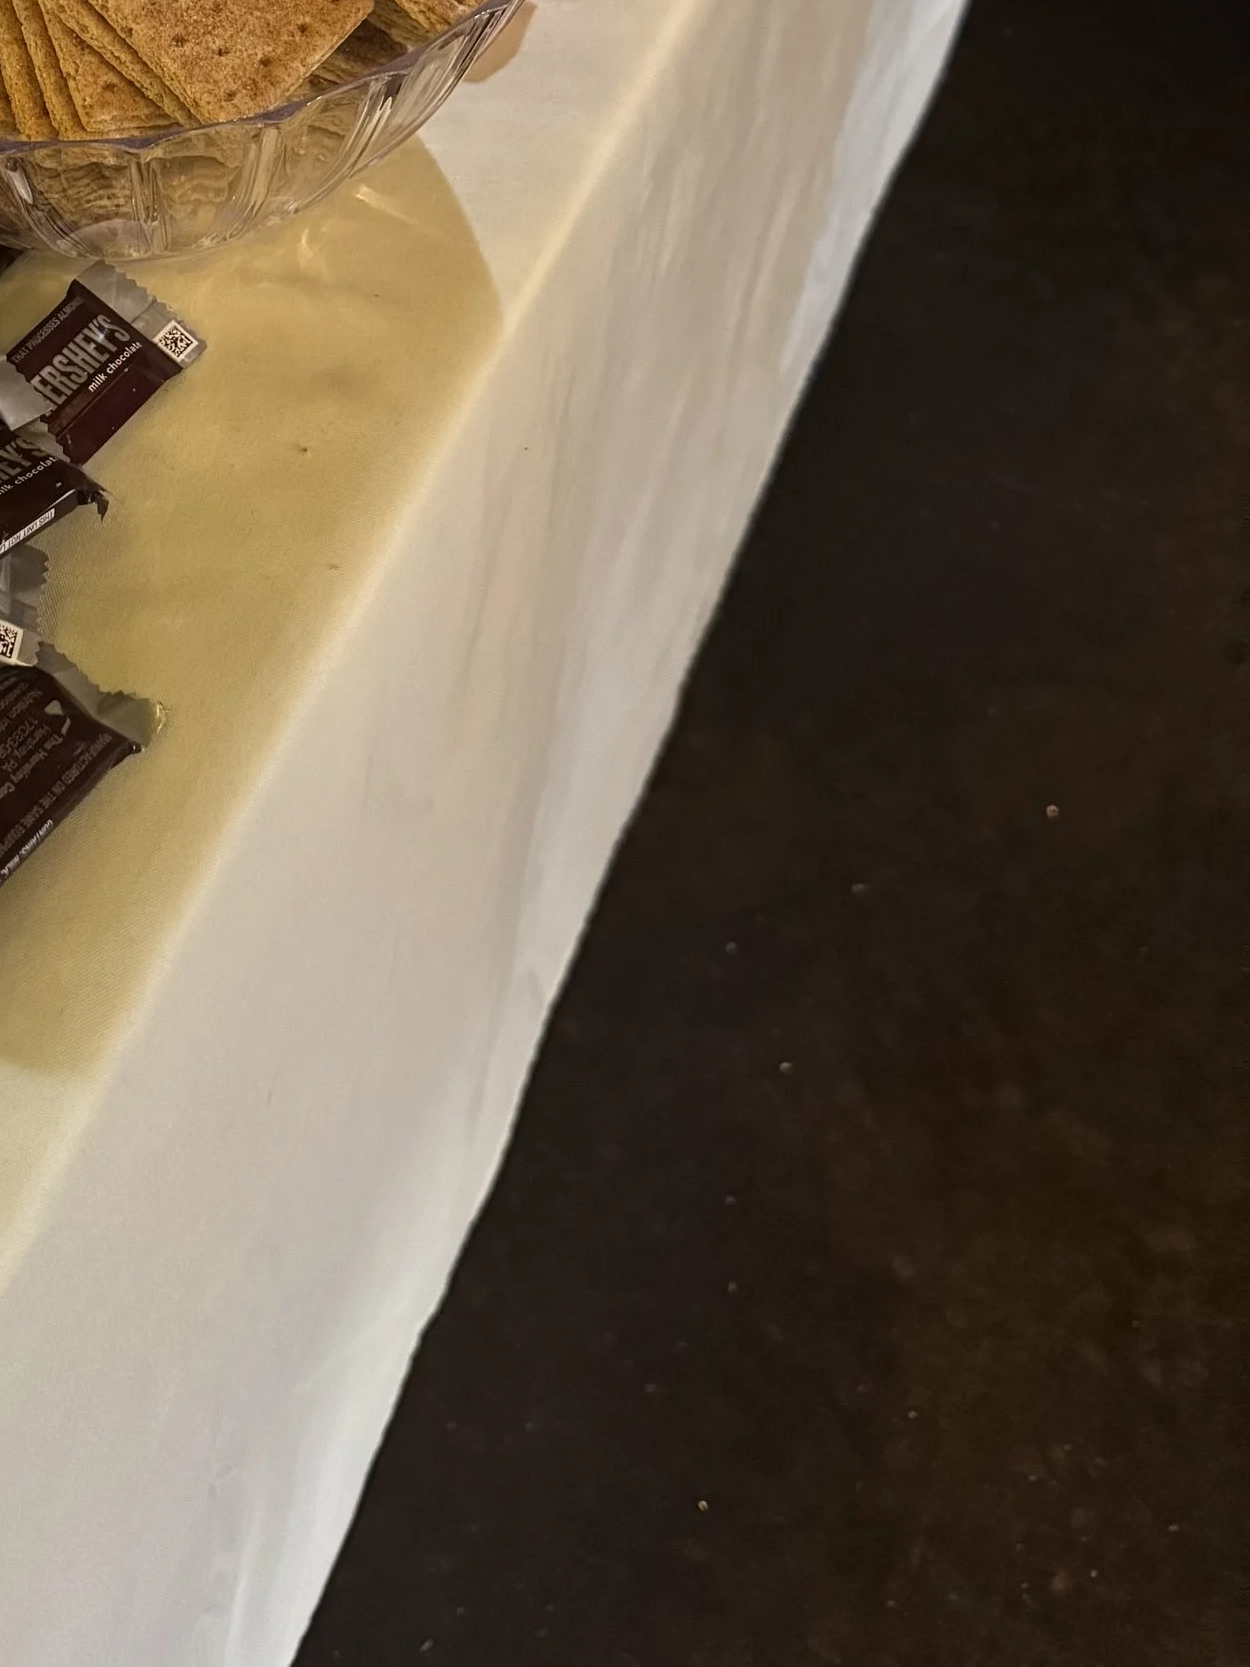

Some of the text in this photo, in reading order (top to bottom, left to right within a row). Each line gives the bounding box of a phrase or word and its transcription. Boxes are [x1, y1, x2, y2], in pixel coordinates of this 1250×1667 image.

[30, 314, 130, 417] ERSHEY'S
[88, 340, 142, 393] milk chocolate
